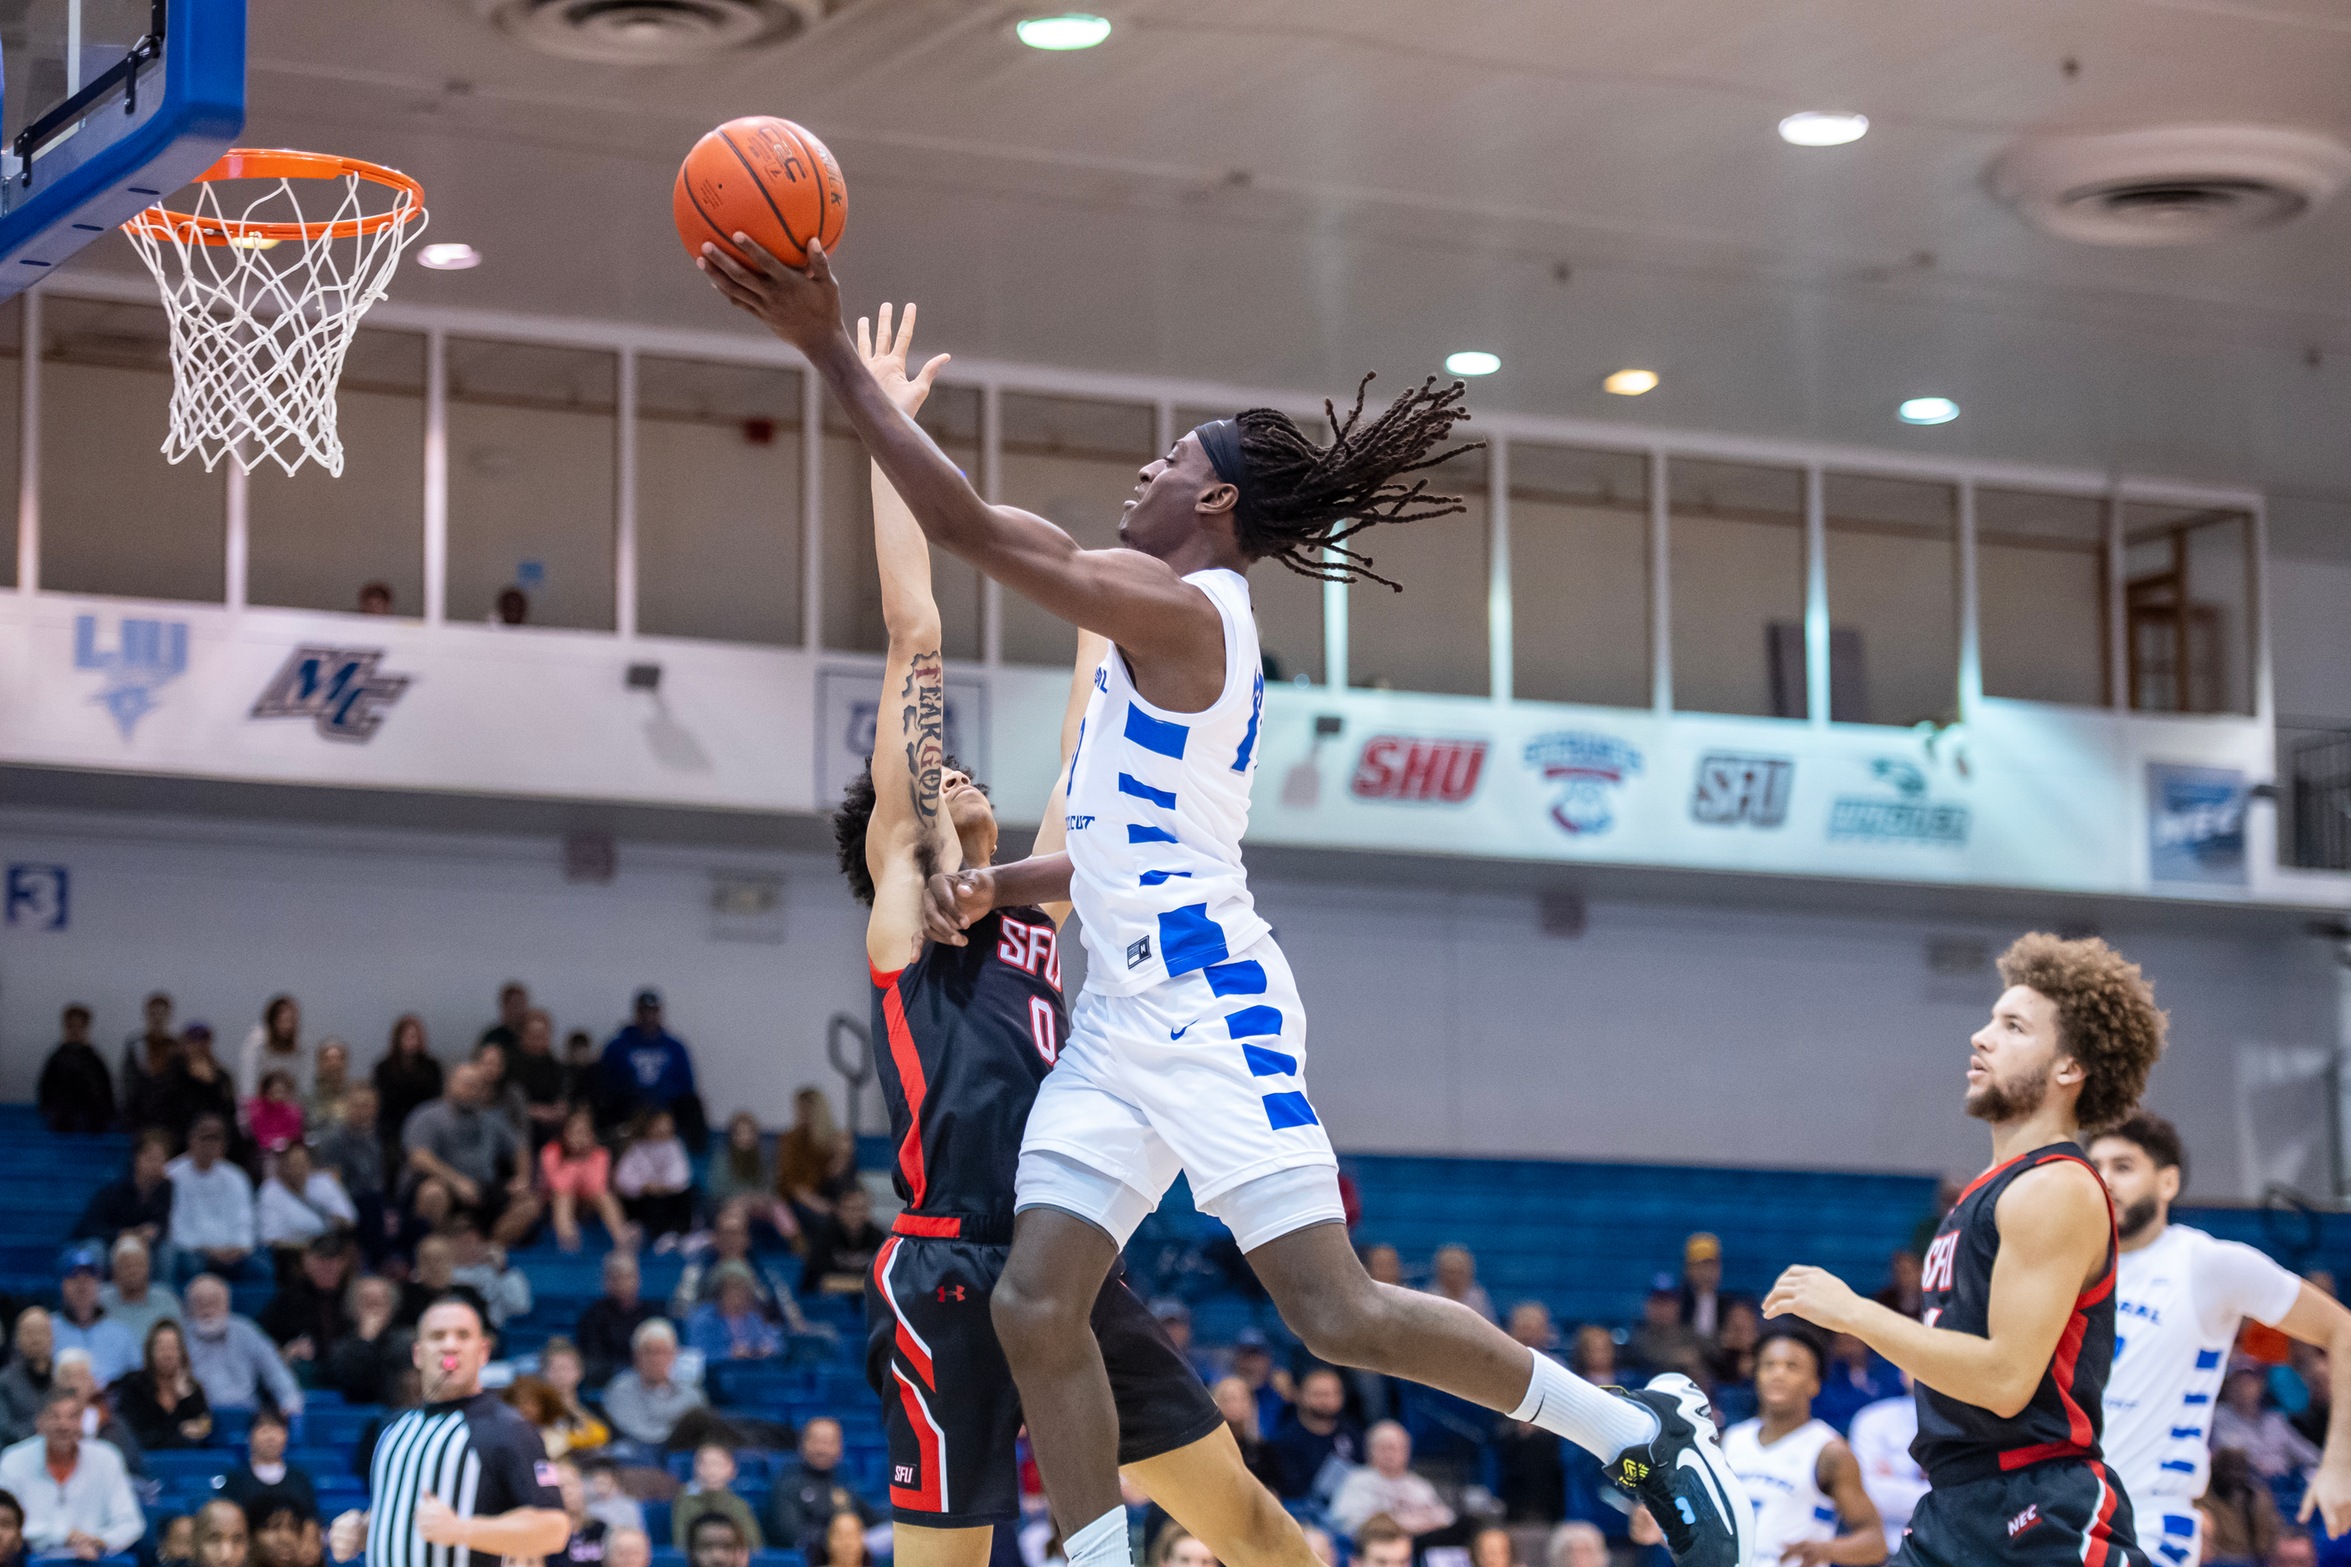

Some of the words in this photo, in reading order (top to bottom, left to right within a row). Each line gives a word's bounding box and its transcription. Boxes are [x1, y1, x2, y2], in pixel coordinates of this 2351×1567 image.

[74, 614, 188, 682] LIU
[248, 643, 413, 743] MC
[1351, 734, 1492, 804] SHU
[1693, 751, 1794, 828] SFU
[14, 872, 59, 928] 3
[894, 1464, 913, 1484] SFU
[2007, 1503, 2038, 1537] NEC
